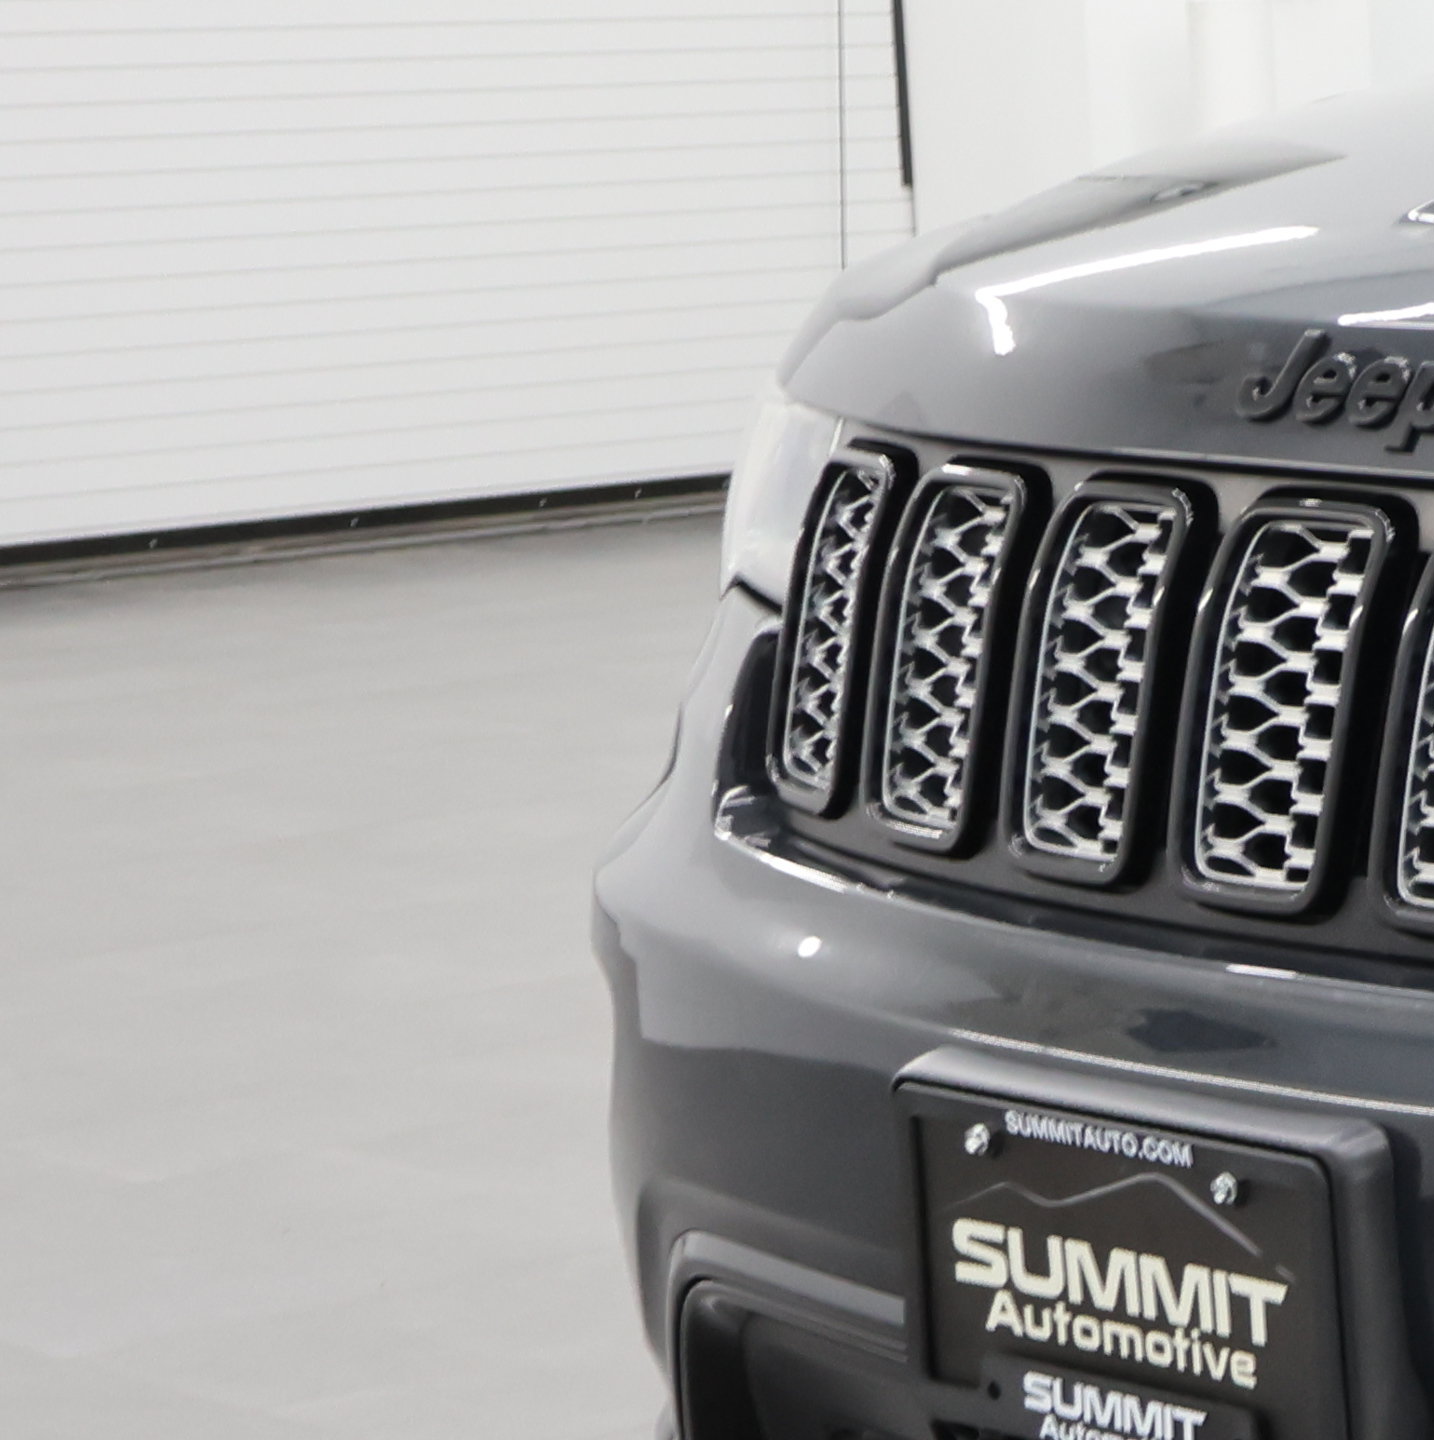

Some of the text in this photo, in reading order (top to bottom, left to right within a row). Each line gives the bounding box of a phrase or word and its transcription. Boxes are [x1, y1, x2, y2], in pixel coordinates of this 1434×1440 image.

[1004, 1109, 1194, 1168] SUMMITAUTO.COM
[951, 1217, 1289, 1346] SUMMIT
[985, 1290, 1258, 1389] Automotive
